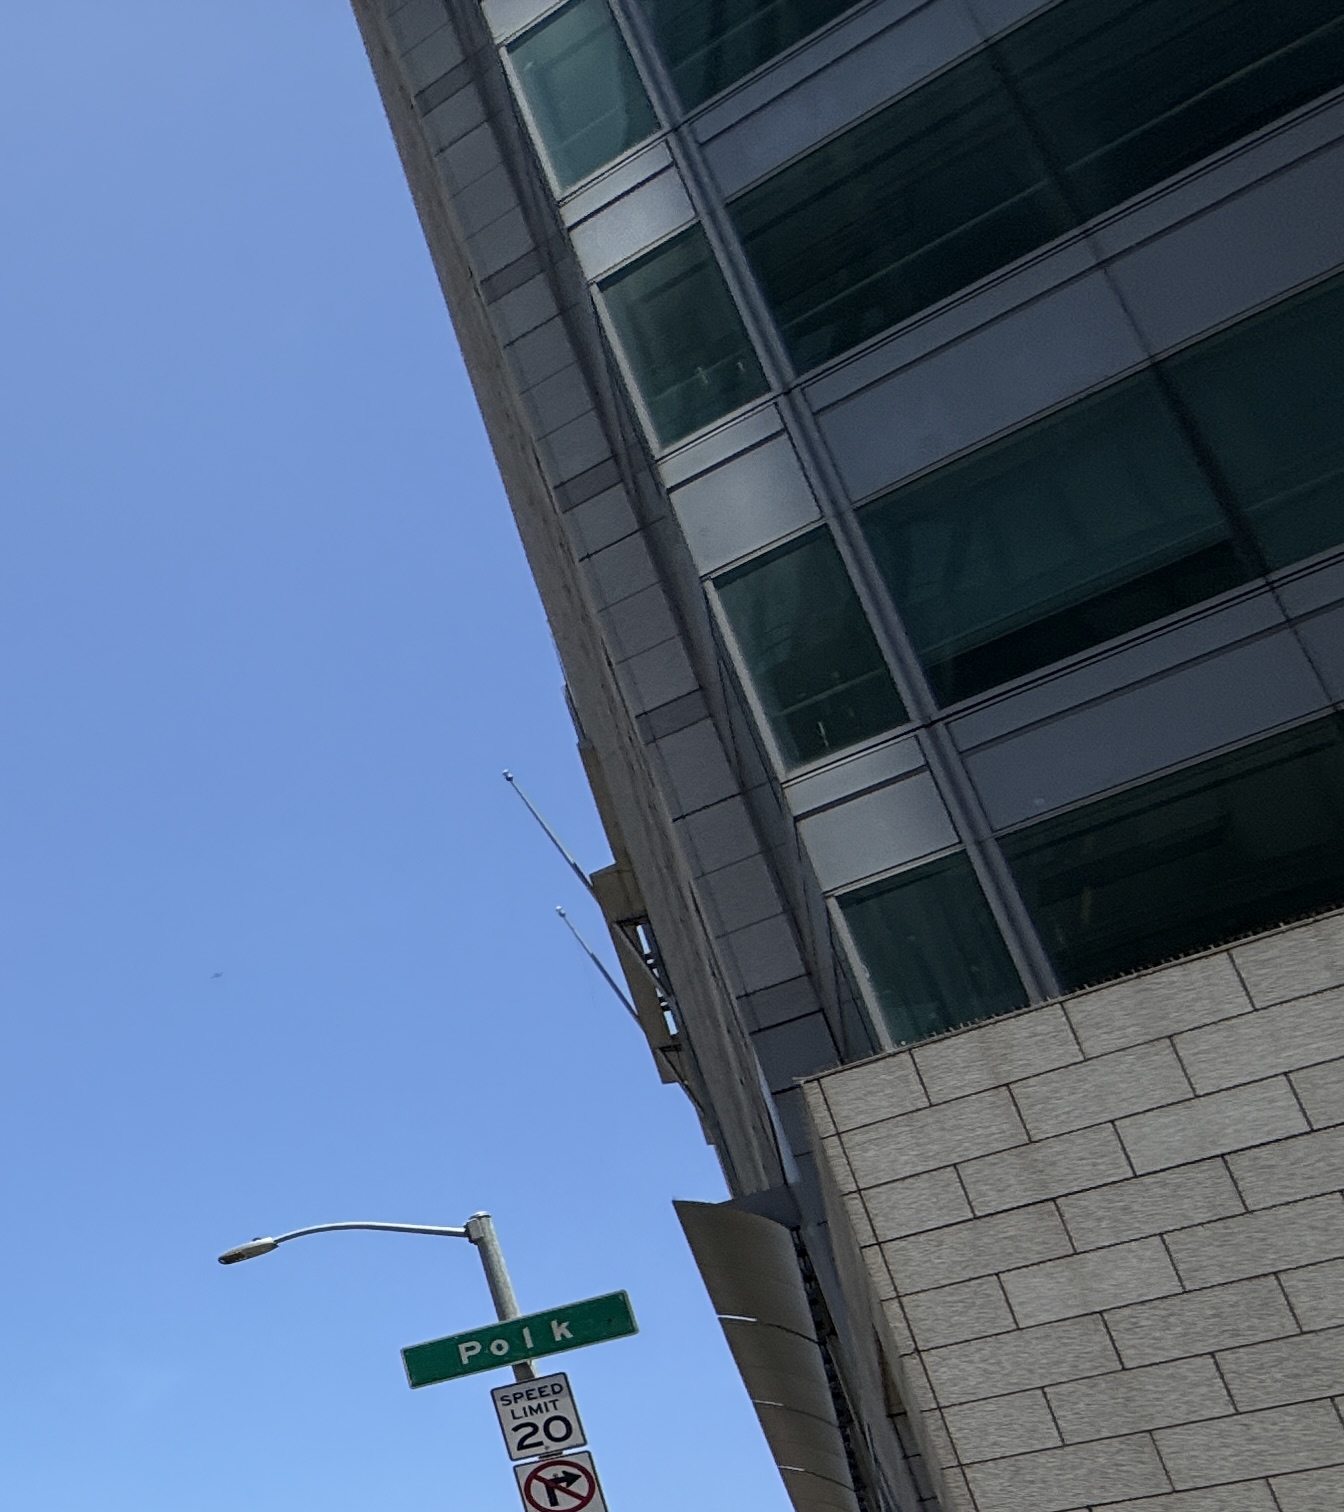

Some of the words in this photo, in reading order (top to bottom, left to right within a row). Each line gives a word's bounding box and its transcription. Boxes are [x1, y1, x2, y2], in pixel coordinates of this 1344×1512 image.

[458, 1318, 574, 1365] Polk
[499, 1382, 564, 1407] SPEED
[511, 1400, 560, 1420] LIMIT
[511, 1415, 574, 1452] 20
